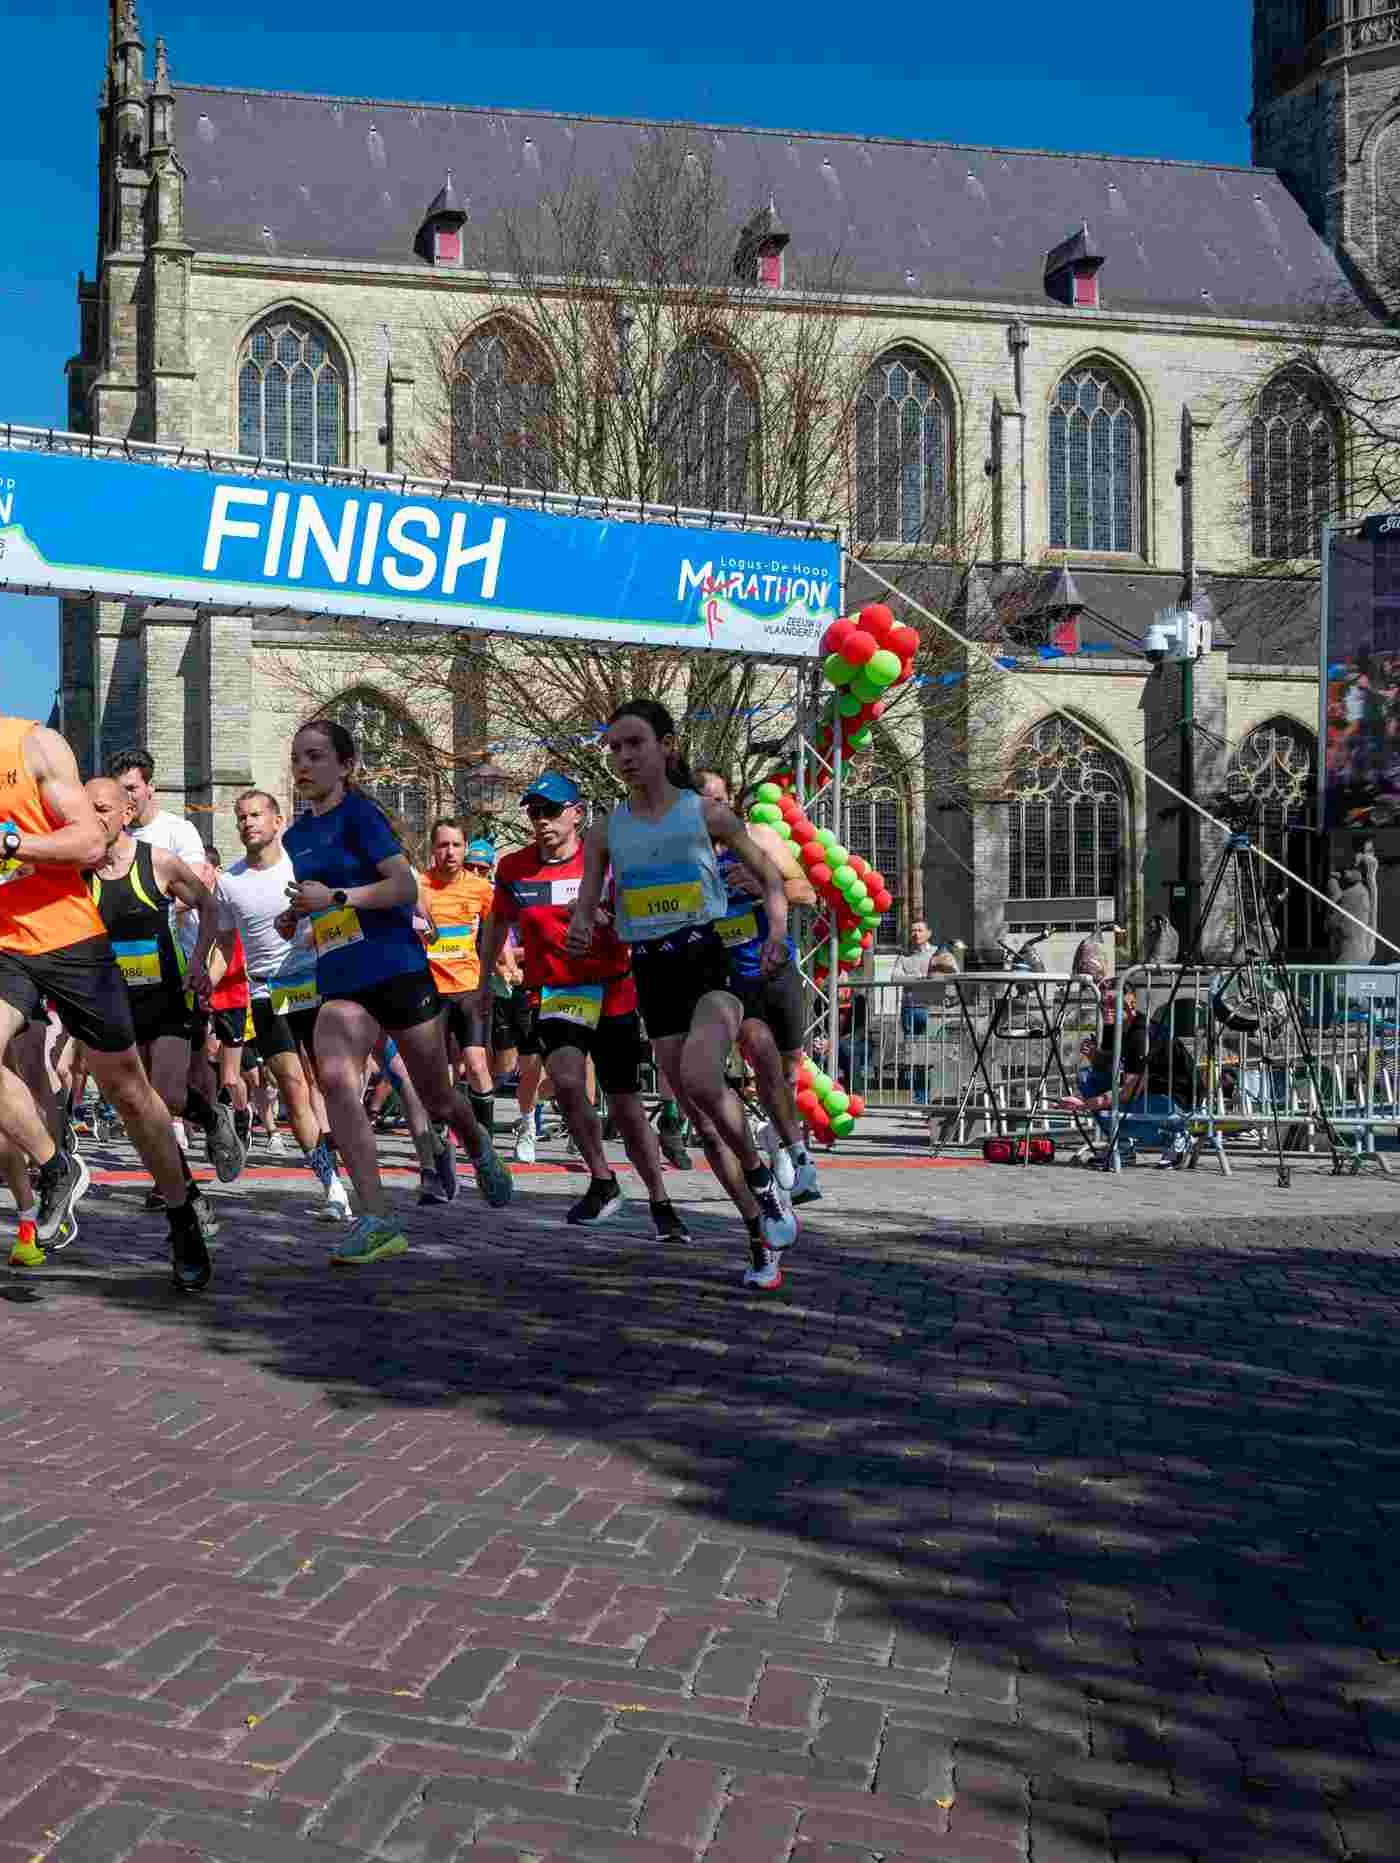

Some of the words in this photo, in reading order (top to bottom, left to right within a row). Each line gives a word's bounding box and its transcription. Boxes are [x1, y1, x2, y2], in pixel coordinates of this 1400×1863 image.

[202, 484, 506, 600] FINISH
[720, 555, 788, 572] Logus-De
[677, 558, 831, 608] MARATHON
[763, 624, 823, 639] VLAANDEREN
[647, 898, 680, 914] 1100
